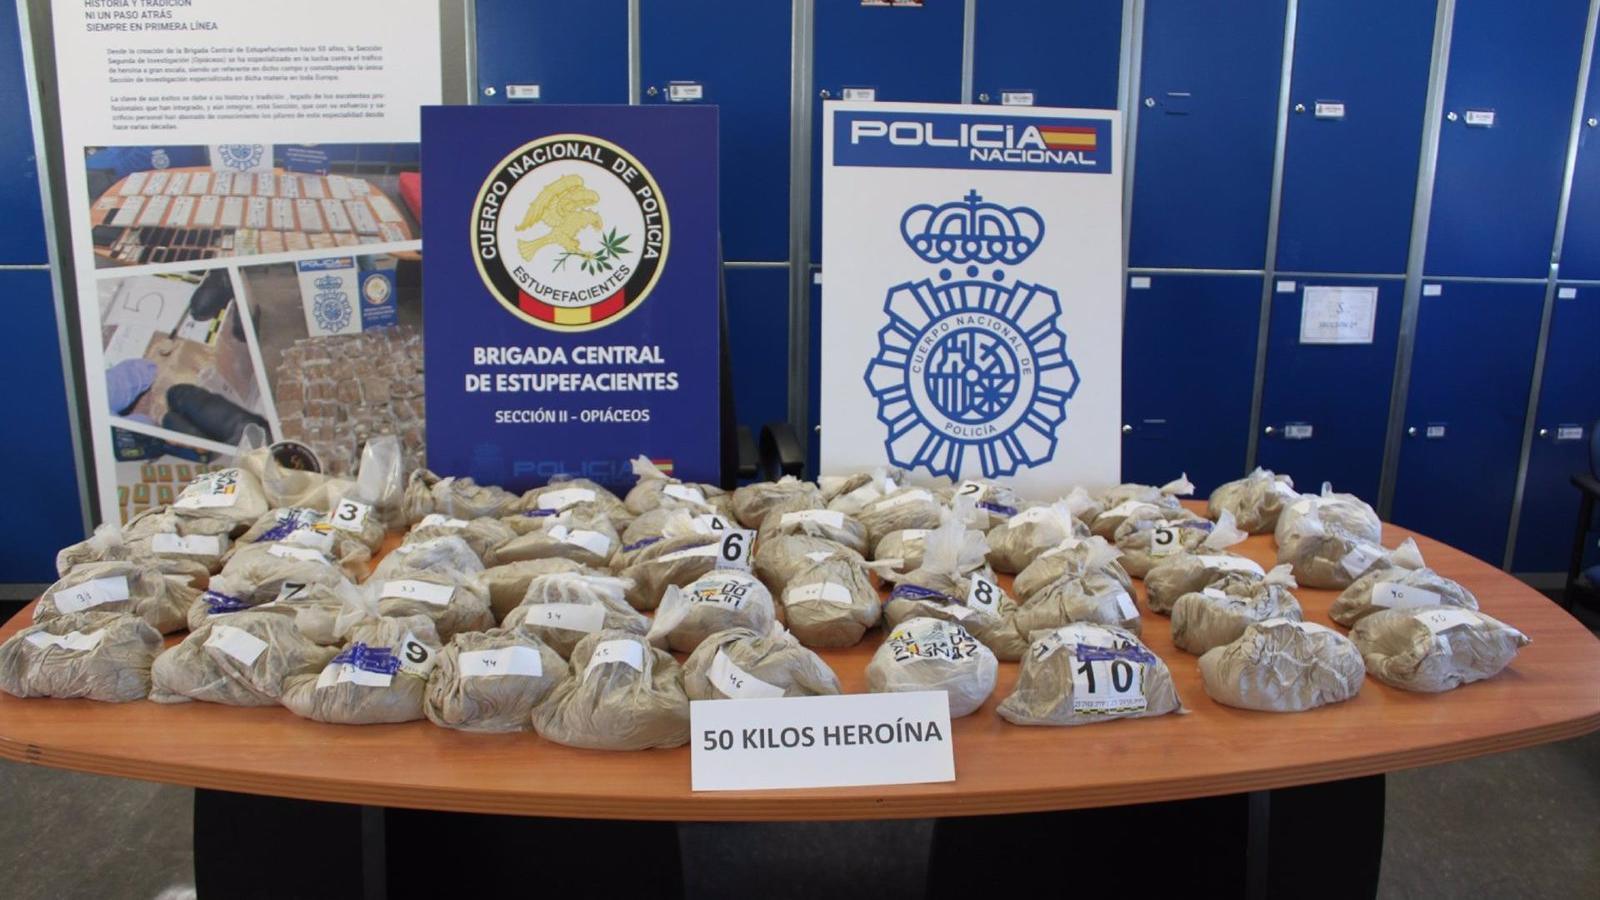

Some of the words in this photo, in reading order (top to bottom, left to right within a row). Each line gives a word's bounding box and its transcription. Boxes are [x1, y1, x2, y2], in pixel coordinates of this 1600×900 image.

[85, 11, 94, 19] NI
[97, 11, 110, 19] UN
[113, 10, 138, 19] PASO
[140, 8, 172, 18] ATRÁS
[86, 22, 127, 31] SIEMPRE
[130, 22, 142, 31] EN
[145, 21, 187, 31] PRIMERA
[189, 19, 218, 30] LÍNEA
[970, 149, 1096, 164] NACIONAL
[480, 181, 507, 259] CUERPO
[507, 142, 603, 178] NACIONAL
[612, 157, 638, 183] DE
[513, 264, 631, 302] ESTUPEFACIENTES
[474, 346, 568, 365] BRIGADA
[571, 345, 664, 364] CENTRAL
[912, 322, 949, 374] CUERPO
[956, 316, 1022, 351] NACIONAL
[1020, 358, 1032, 376] DE
[465, 374, 491, 392] DE
[495, 372, 679, 391] ESTUPEFACIENTES
[494, 407, 556, 423] SECCIÓN
[559, 410, 568, 422] II
[580, 406, 650, 423] OPIÁCEOS
[339, 503, 358, 521] 3
[1155, 527, 1173, 545] 5
[722, 532, 744, 561] 6
[284, 582, 306, 600] 7
[975, 579, 993, 605] 8
[405, 640, 428, 664] 9
[482, 658, 497, 668] 44
[730, 674, 745, 689] 46
[1077, 659, 1134, 694] 10
[703, 728, 734, 751] 50
[742, 726, 816, 750] KILOS
[822, 716, 944, 747] HEROÍNA
